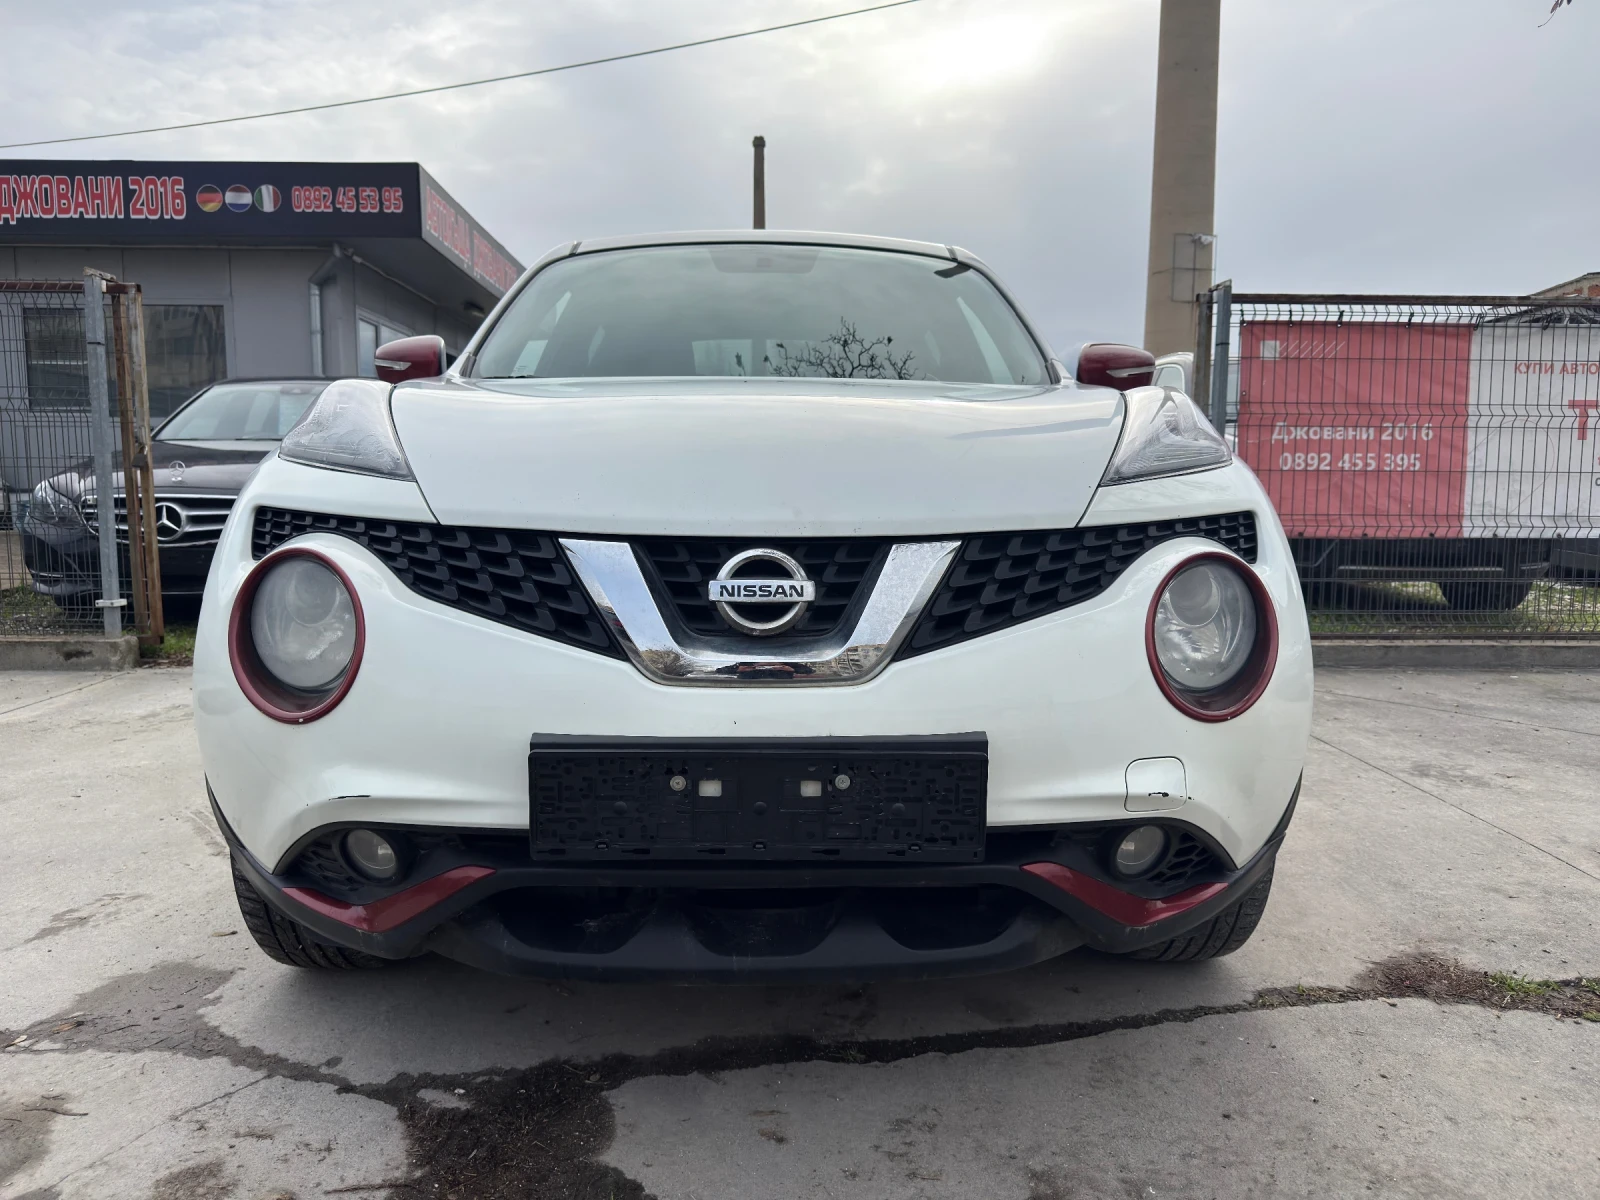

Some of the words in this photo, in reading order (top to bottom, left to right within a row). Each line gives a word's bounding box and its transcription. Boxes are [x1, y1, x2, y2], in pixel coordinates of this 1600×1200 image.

[0, 175, 124, 224] ДЖОВАНИ
[129, 176, 187, 220] 2016
[292, 186, 333, 212] 0892
[336, 187, 356, 212] 45
[359, 187, 379, 213] 53
[382, 187, 403, 213] 95
[1514, 362, 1554, 375] КУПИ
[1271, 422, 1375, 444] Джовани
[1381, 423, 1433, 441] 2016
[1279, 452, 1331, 471] 0892
[1338, 453, 1376, 471] 455
[1383, 453, 1421, 471] 395
[719, 584, 804, 598] NISSAN
